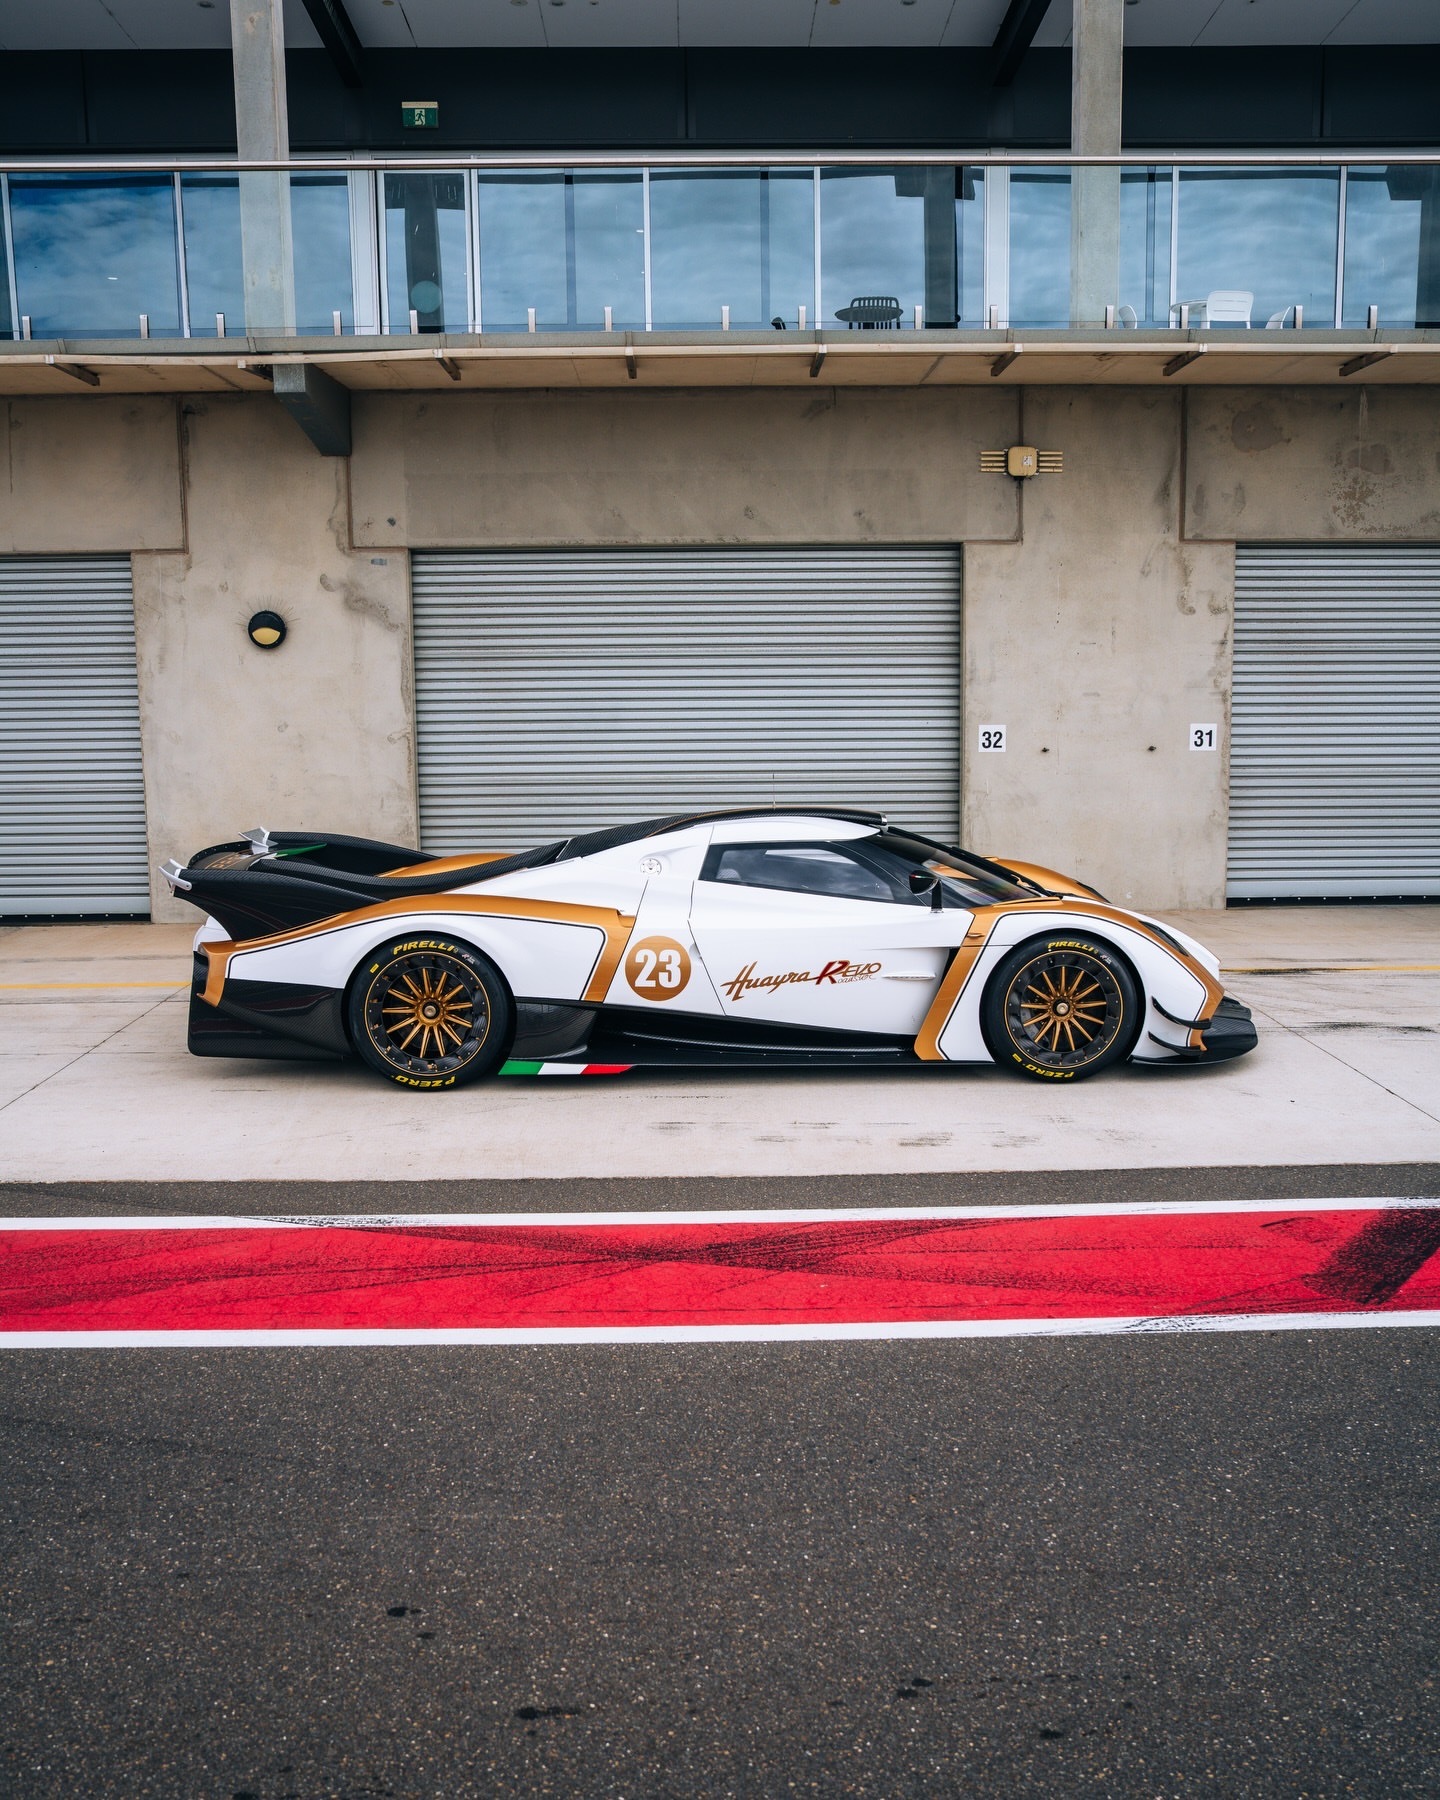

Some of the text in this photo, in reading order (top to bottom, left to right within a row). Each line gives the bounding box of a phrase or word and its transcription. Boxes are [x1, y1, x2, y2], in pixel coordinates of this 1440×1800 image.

[982, 731, 1003, 749] 32
[1194, 729, 1213, 748] 31
[393, 940, 455, 955] PIRELLI
[1047, 941, 1094, 952] PIRELLI
[635, 948, 681, 988] 23
[720, 961, 813, 1001] Huayra
